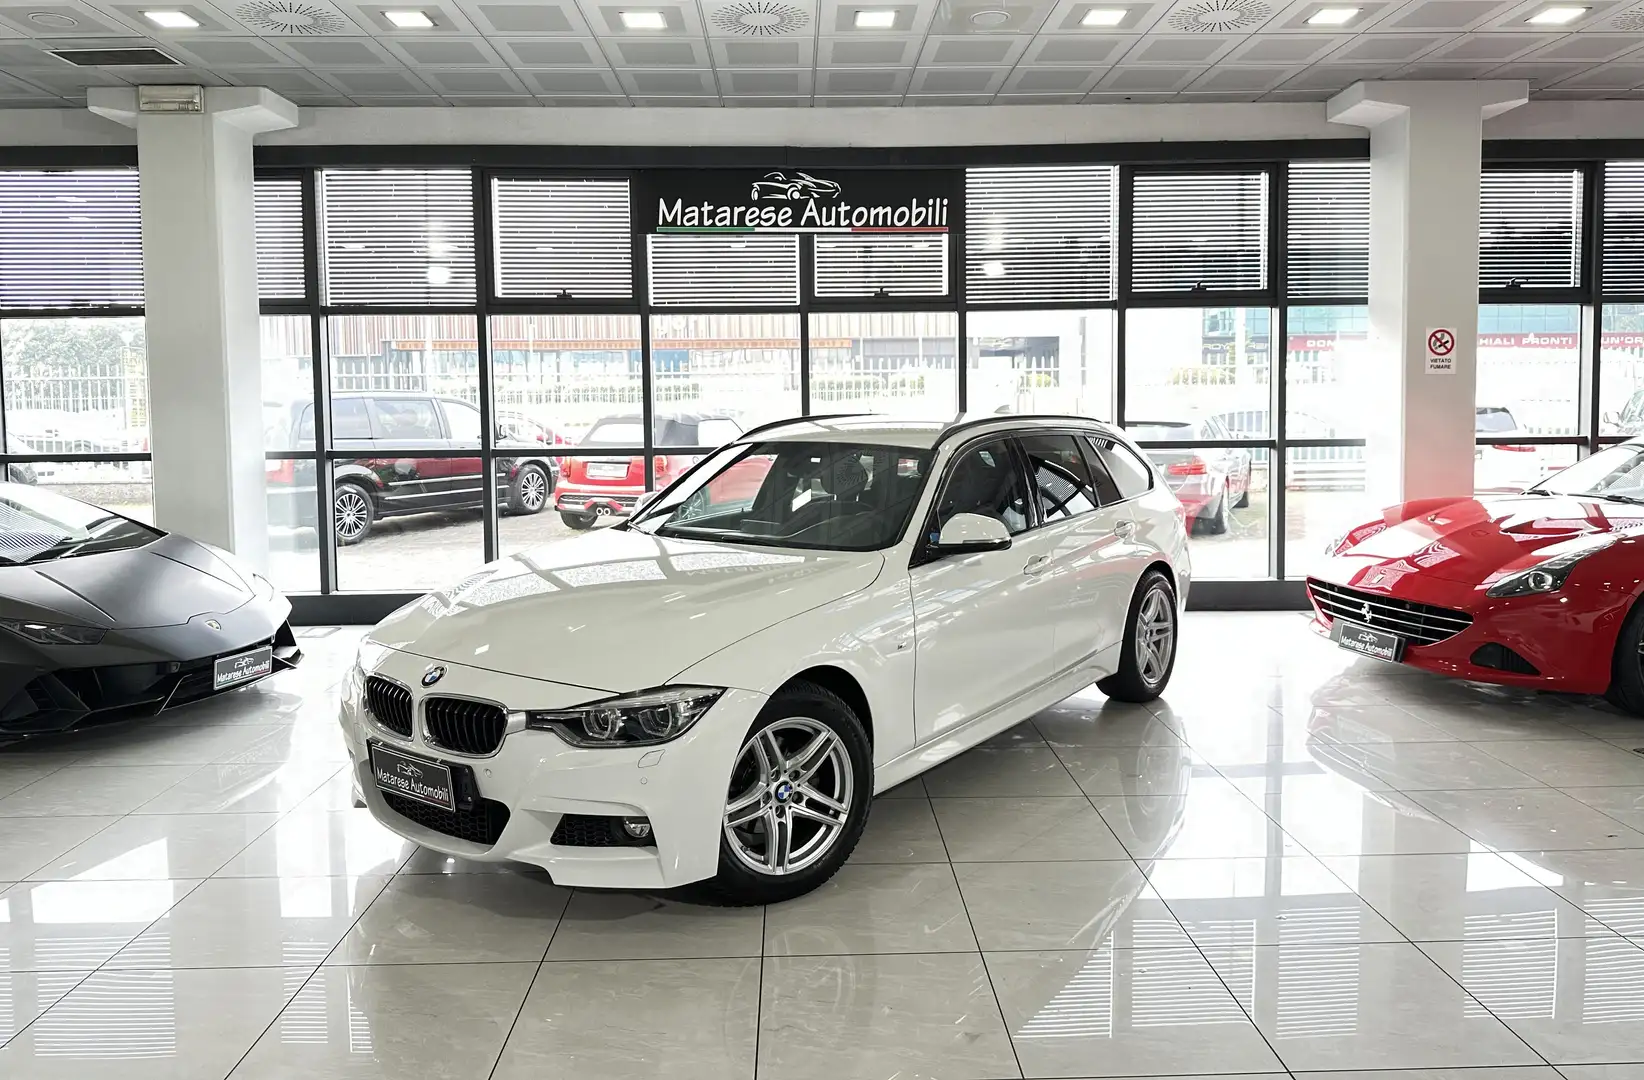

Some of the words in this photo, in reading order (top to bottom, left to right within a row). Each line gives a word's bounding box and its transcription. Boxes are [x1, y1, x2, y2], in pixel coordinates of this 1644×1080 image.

[657, 197, 793, 227] Matarese
[800, 197, 949, 227] Automobili
[1521, 336, 1572, 345] PRONTI
[1341, 635, 1365, 650] Matarese
[1365, 642, 1393, 657] Automobili
[376, 766, 410, 790] Matarese
[410, 778, 449, 802] Automobili
